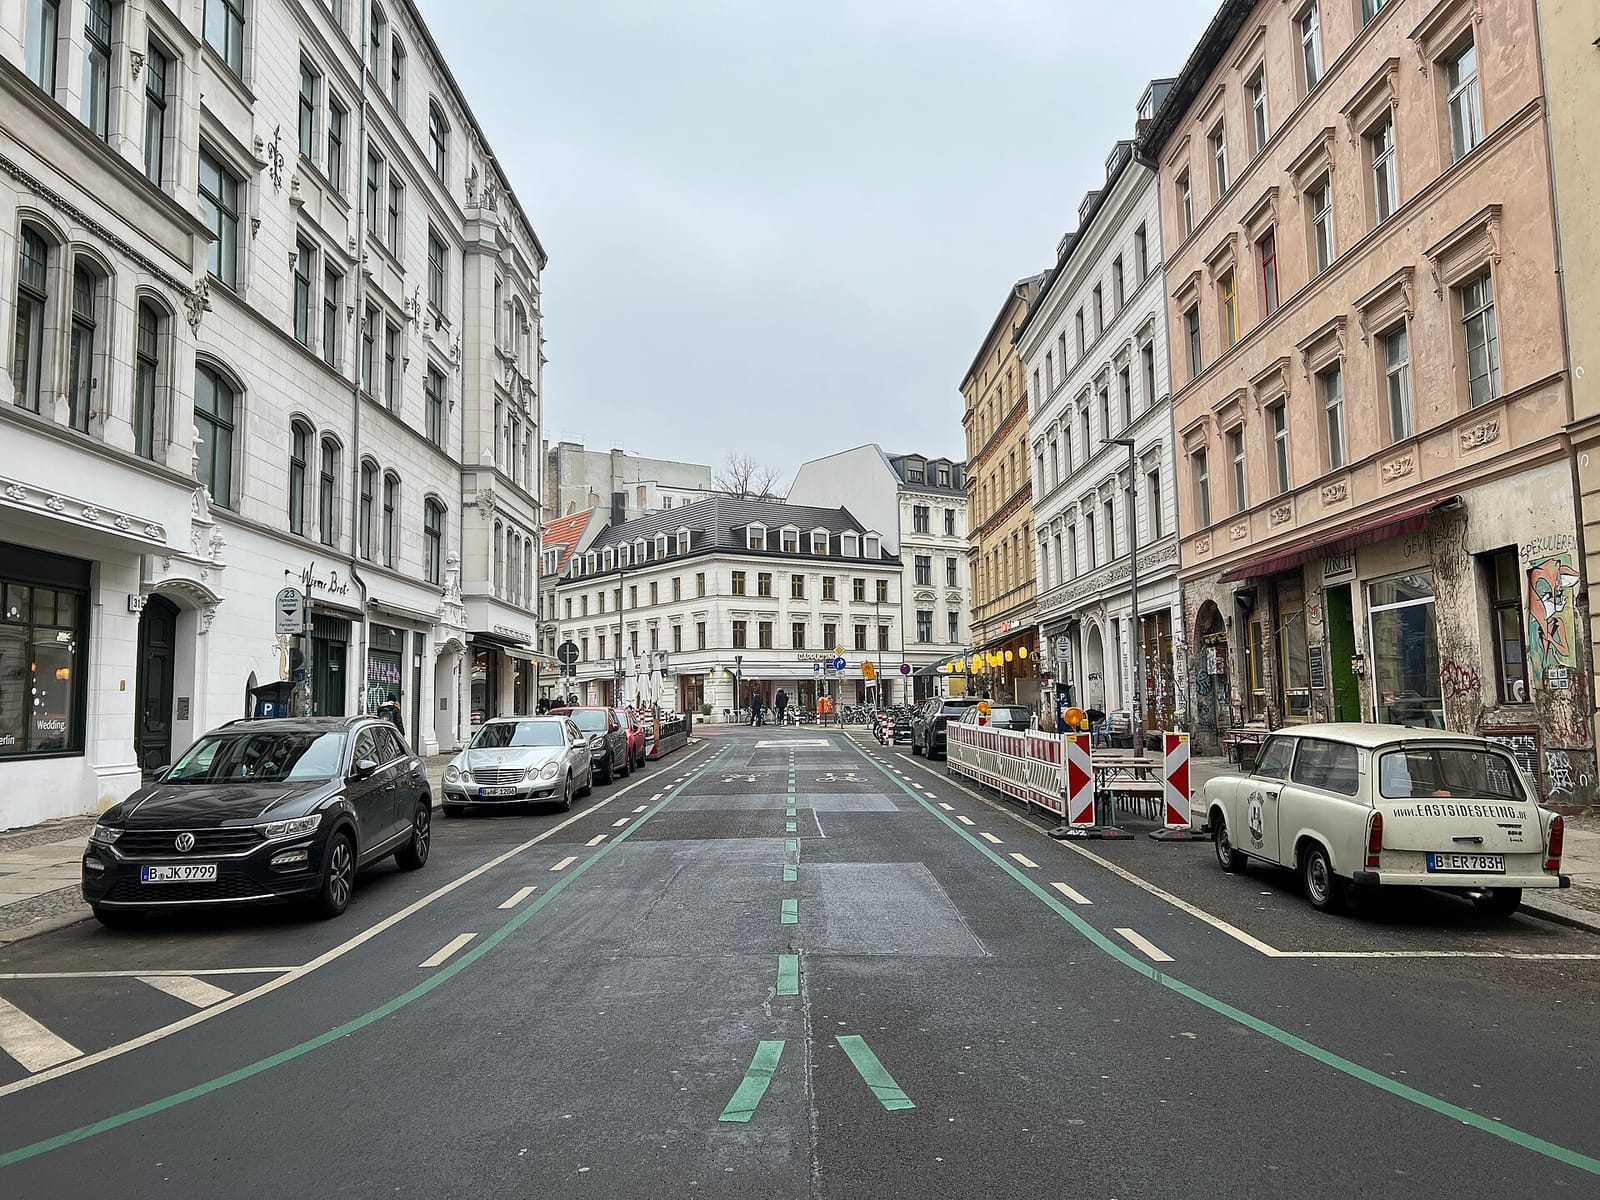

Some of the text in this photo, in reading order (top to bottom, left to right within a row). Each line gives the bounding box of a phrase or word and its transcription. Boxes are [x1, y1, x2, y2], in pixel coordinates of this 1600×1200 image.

[284, 590, 295, 598] 23
[264, 703, 273, 716] P
[184, 866, 215, 879] 9799
